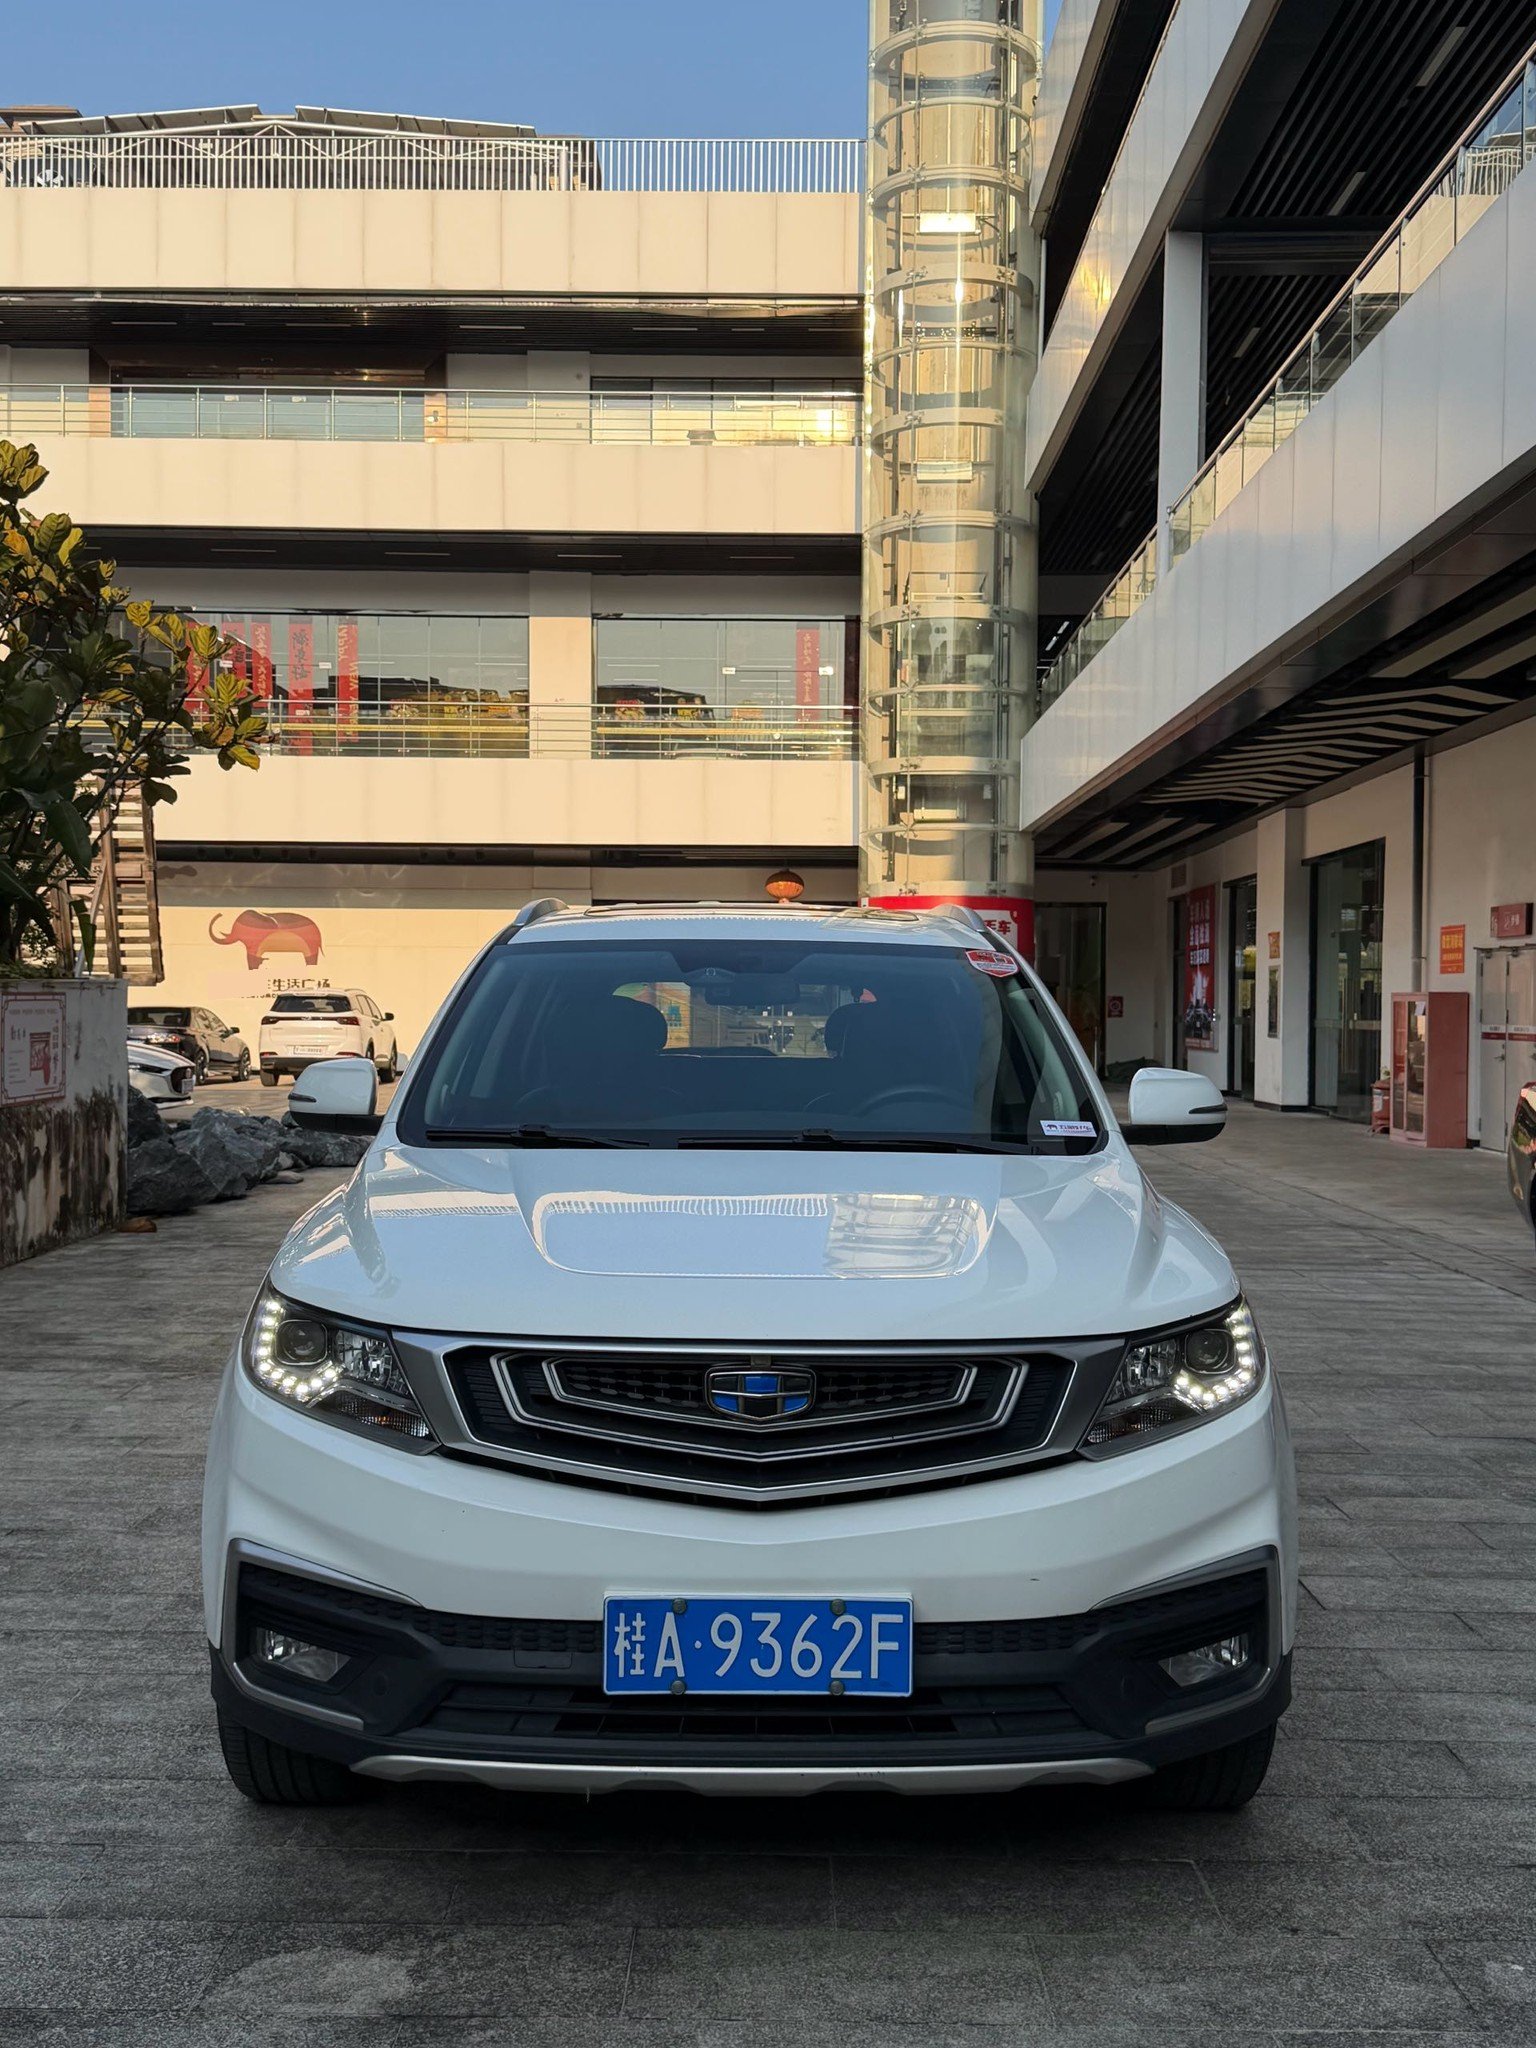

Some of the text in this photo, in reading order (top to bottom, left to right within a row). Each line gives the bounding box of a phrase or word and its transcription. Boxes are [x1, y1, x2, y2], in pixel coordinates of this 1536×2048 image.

[268, 978, 331, 992] 生活广场
[613, 1611, 904, 1679] 桂A·9362F
